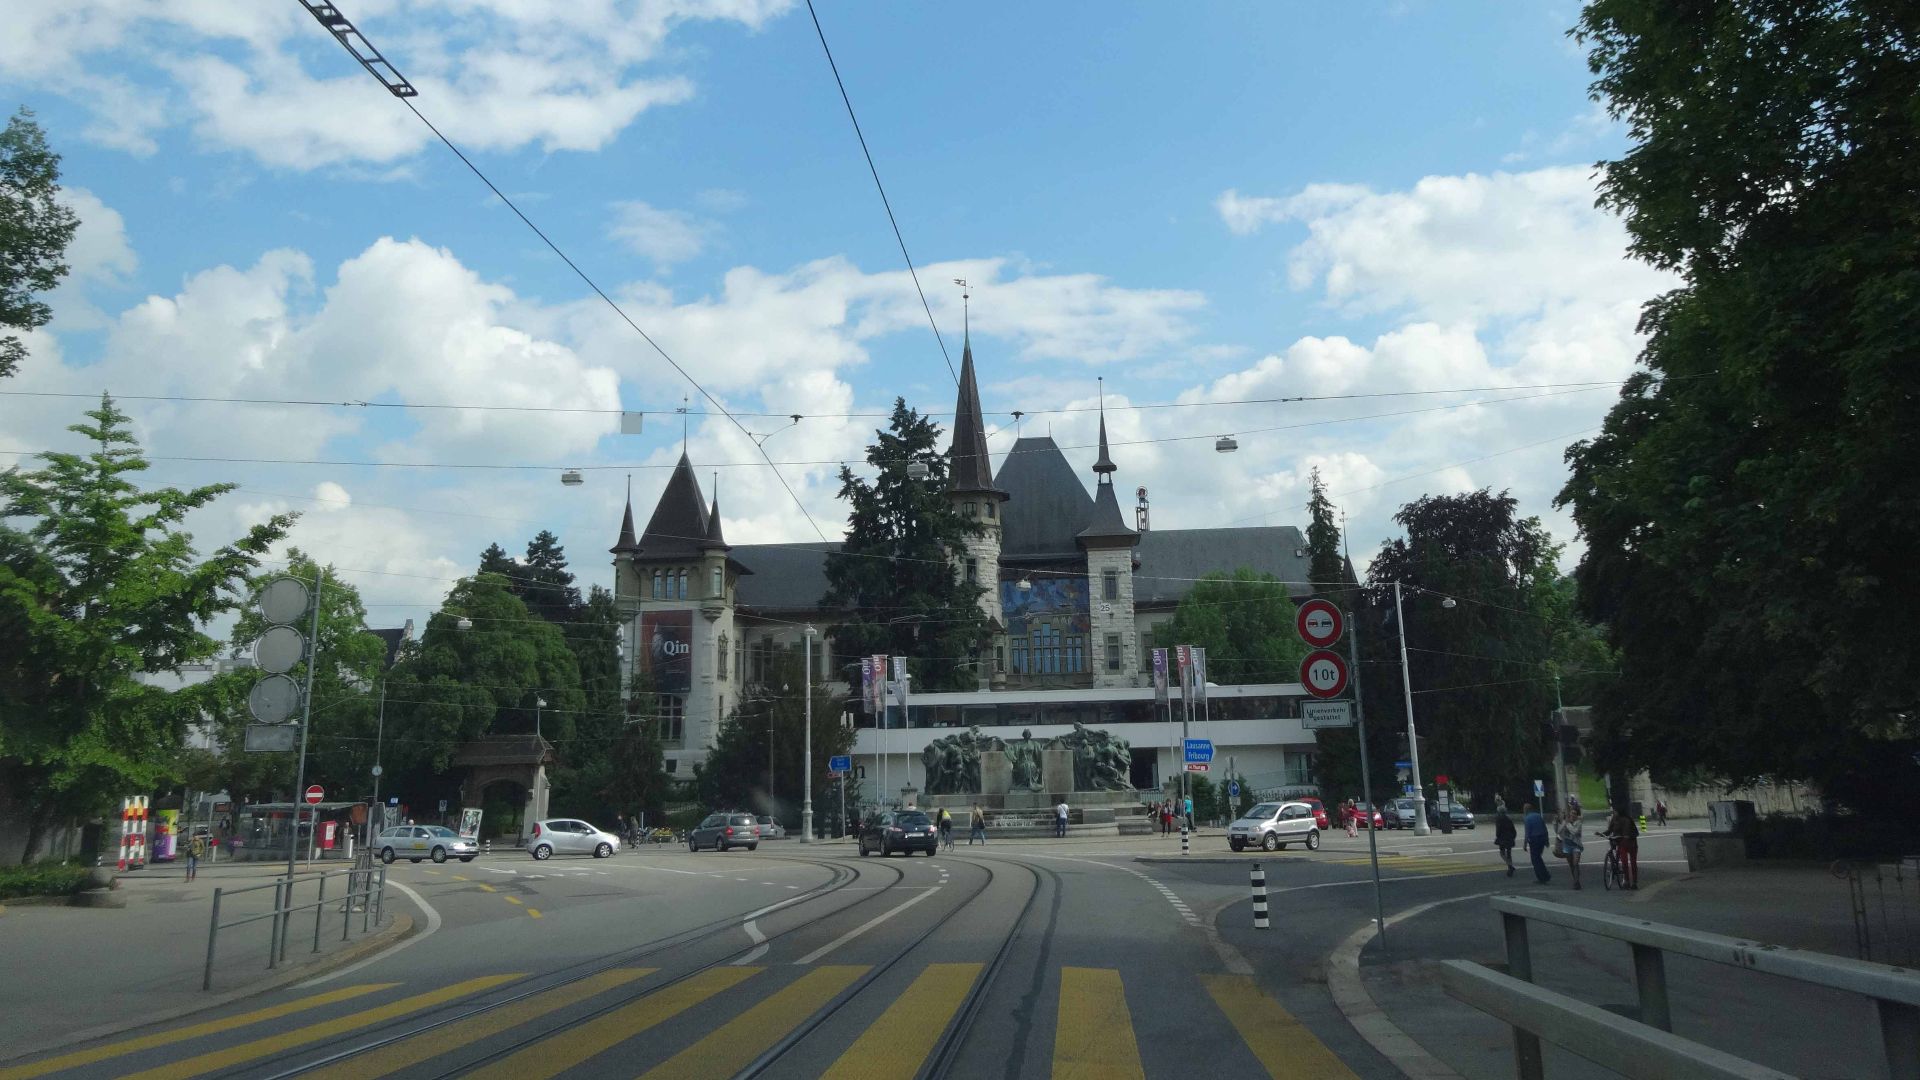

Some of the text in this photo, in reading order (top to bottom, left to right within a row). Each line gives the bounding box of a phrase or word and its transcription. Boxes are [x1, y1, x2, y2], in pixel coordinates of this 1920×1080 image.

[1100, 604, 1111, 612] 25
[663, 640, 689, 656] Qin
[1153, 650, 1161, 665] Qin
[1186, 741, 1211, 750] Lausanne
[1188, 751, 1210, 761] Fribourg
